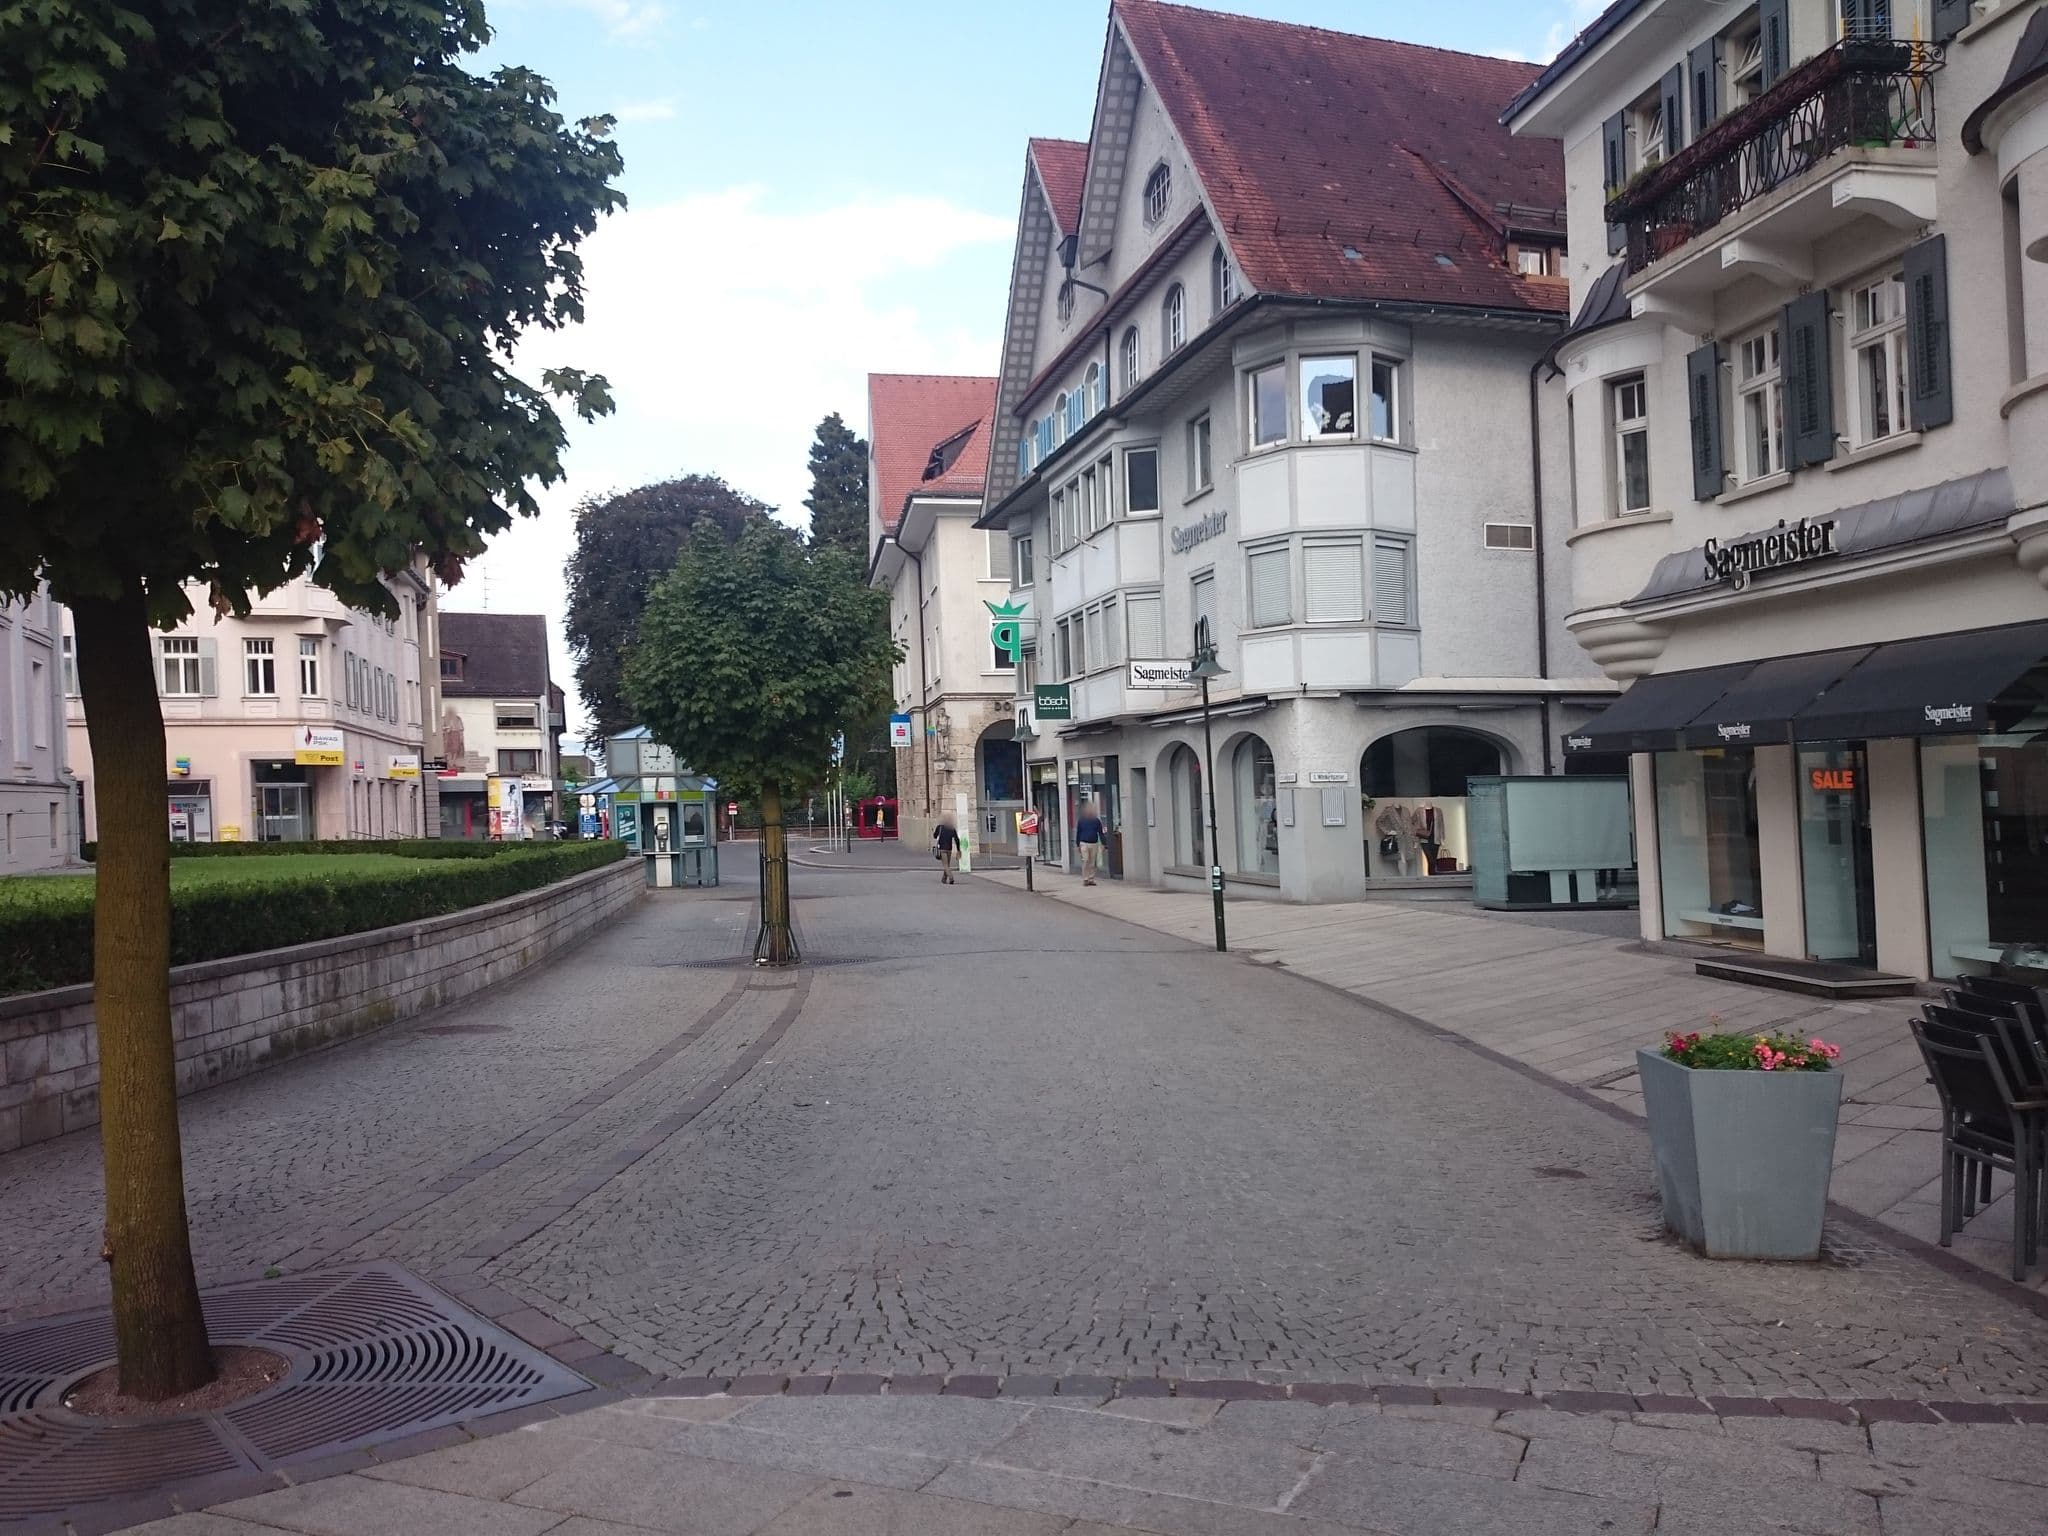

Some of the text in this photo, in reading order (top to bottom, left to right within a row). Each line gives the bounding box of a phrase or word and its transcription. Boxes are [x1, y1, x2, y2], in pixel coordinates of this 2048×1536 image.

[1170, 508, 1228, 555] Sagmeister
[1703, 517, 1837, 591] Sagmeister
[1133, 664, 1192, 682] Sagmeiste
[1924, 702, 1973, 726] Sagmeister
[1717, 721, 1751, 742] Sagmeister
[320, 754, 339, 762] Post
[1812, 769, 1855, 790] SALE
